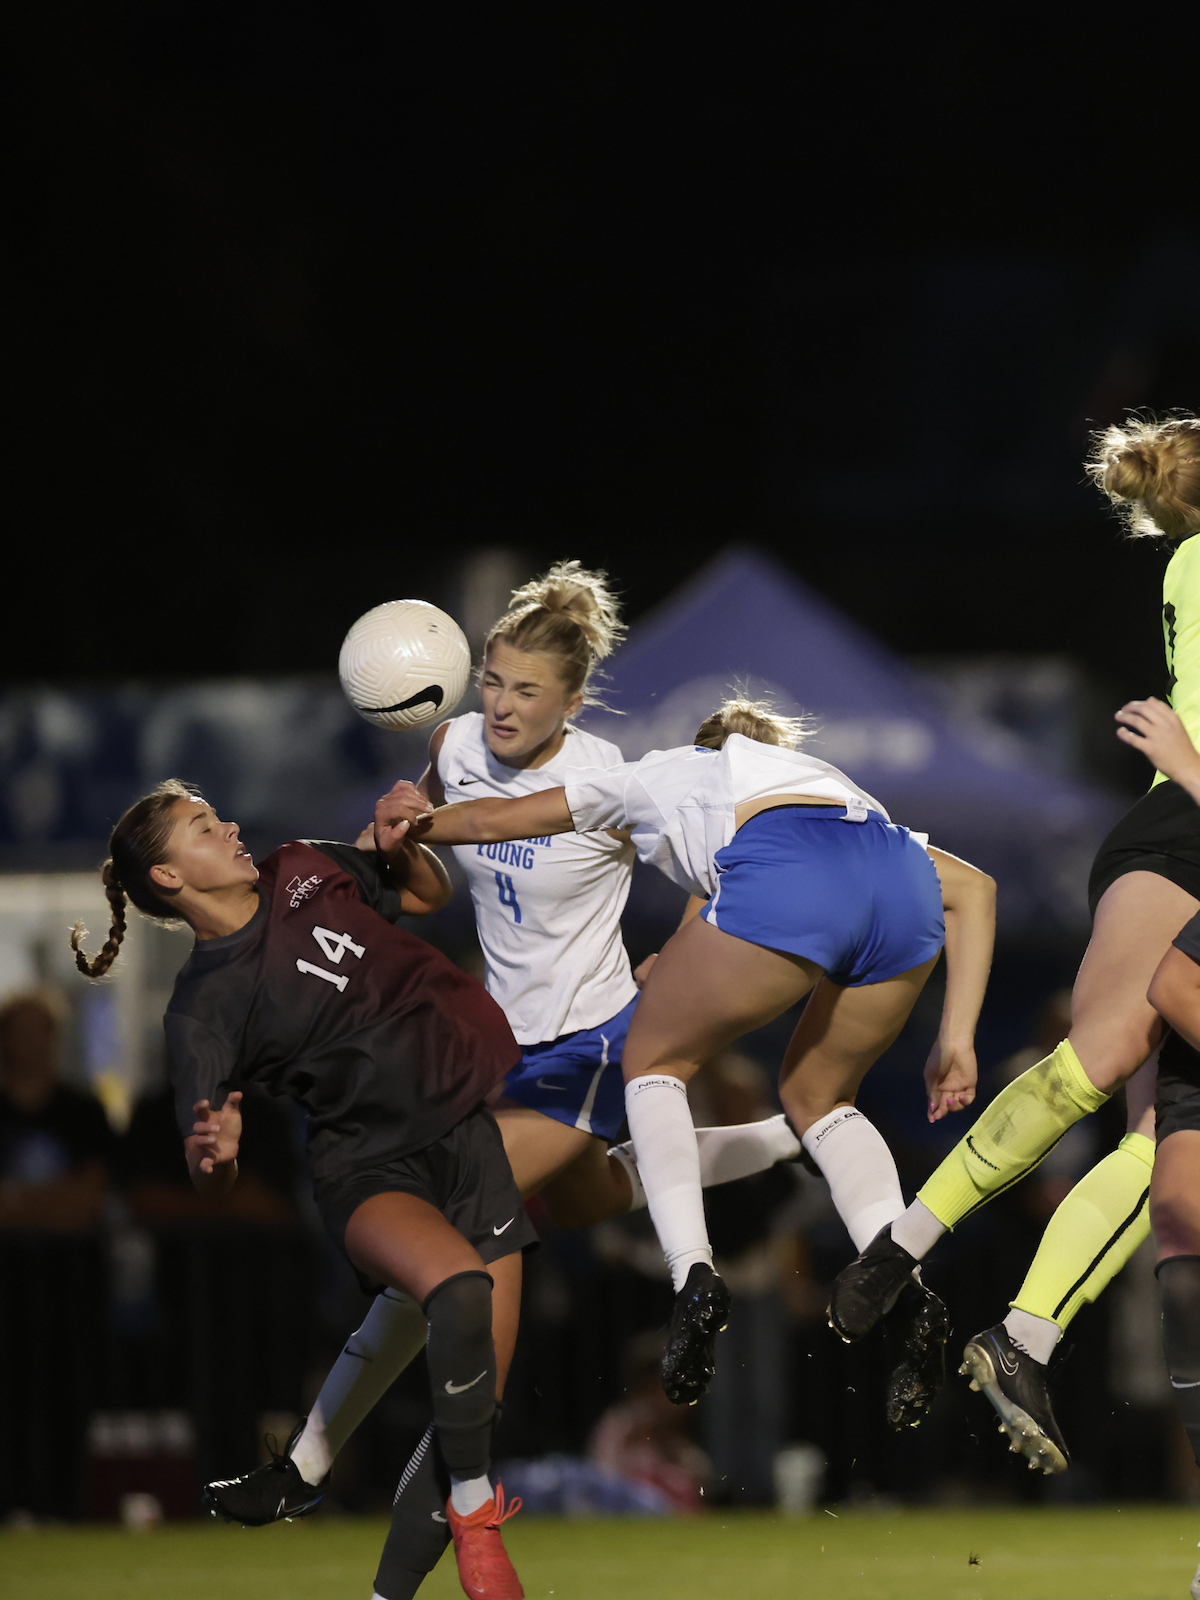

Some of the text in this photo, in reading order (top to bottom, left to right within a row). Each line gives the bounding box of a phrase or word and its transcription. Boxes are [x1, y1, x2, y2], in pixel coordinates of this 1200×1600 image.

[477, 842, 536, 871] YOUNG
[289, 874, 323, 910] STATE
[495, 870, 522, 925] 4
[295, 924, 367, 994] 14
[815, 1116, 843, 1141] NIKE
